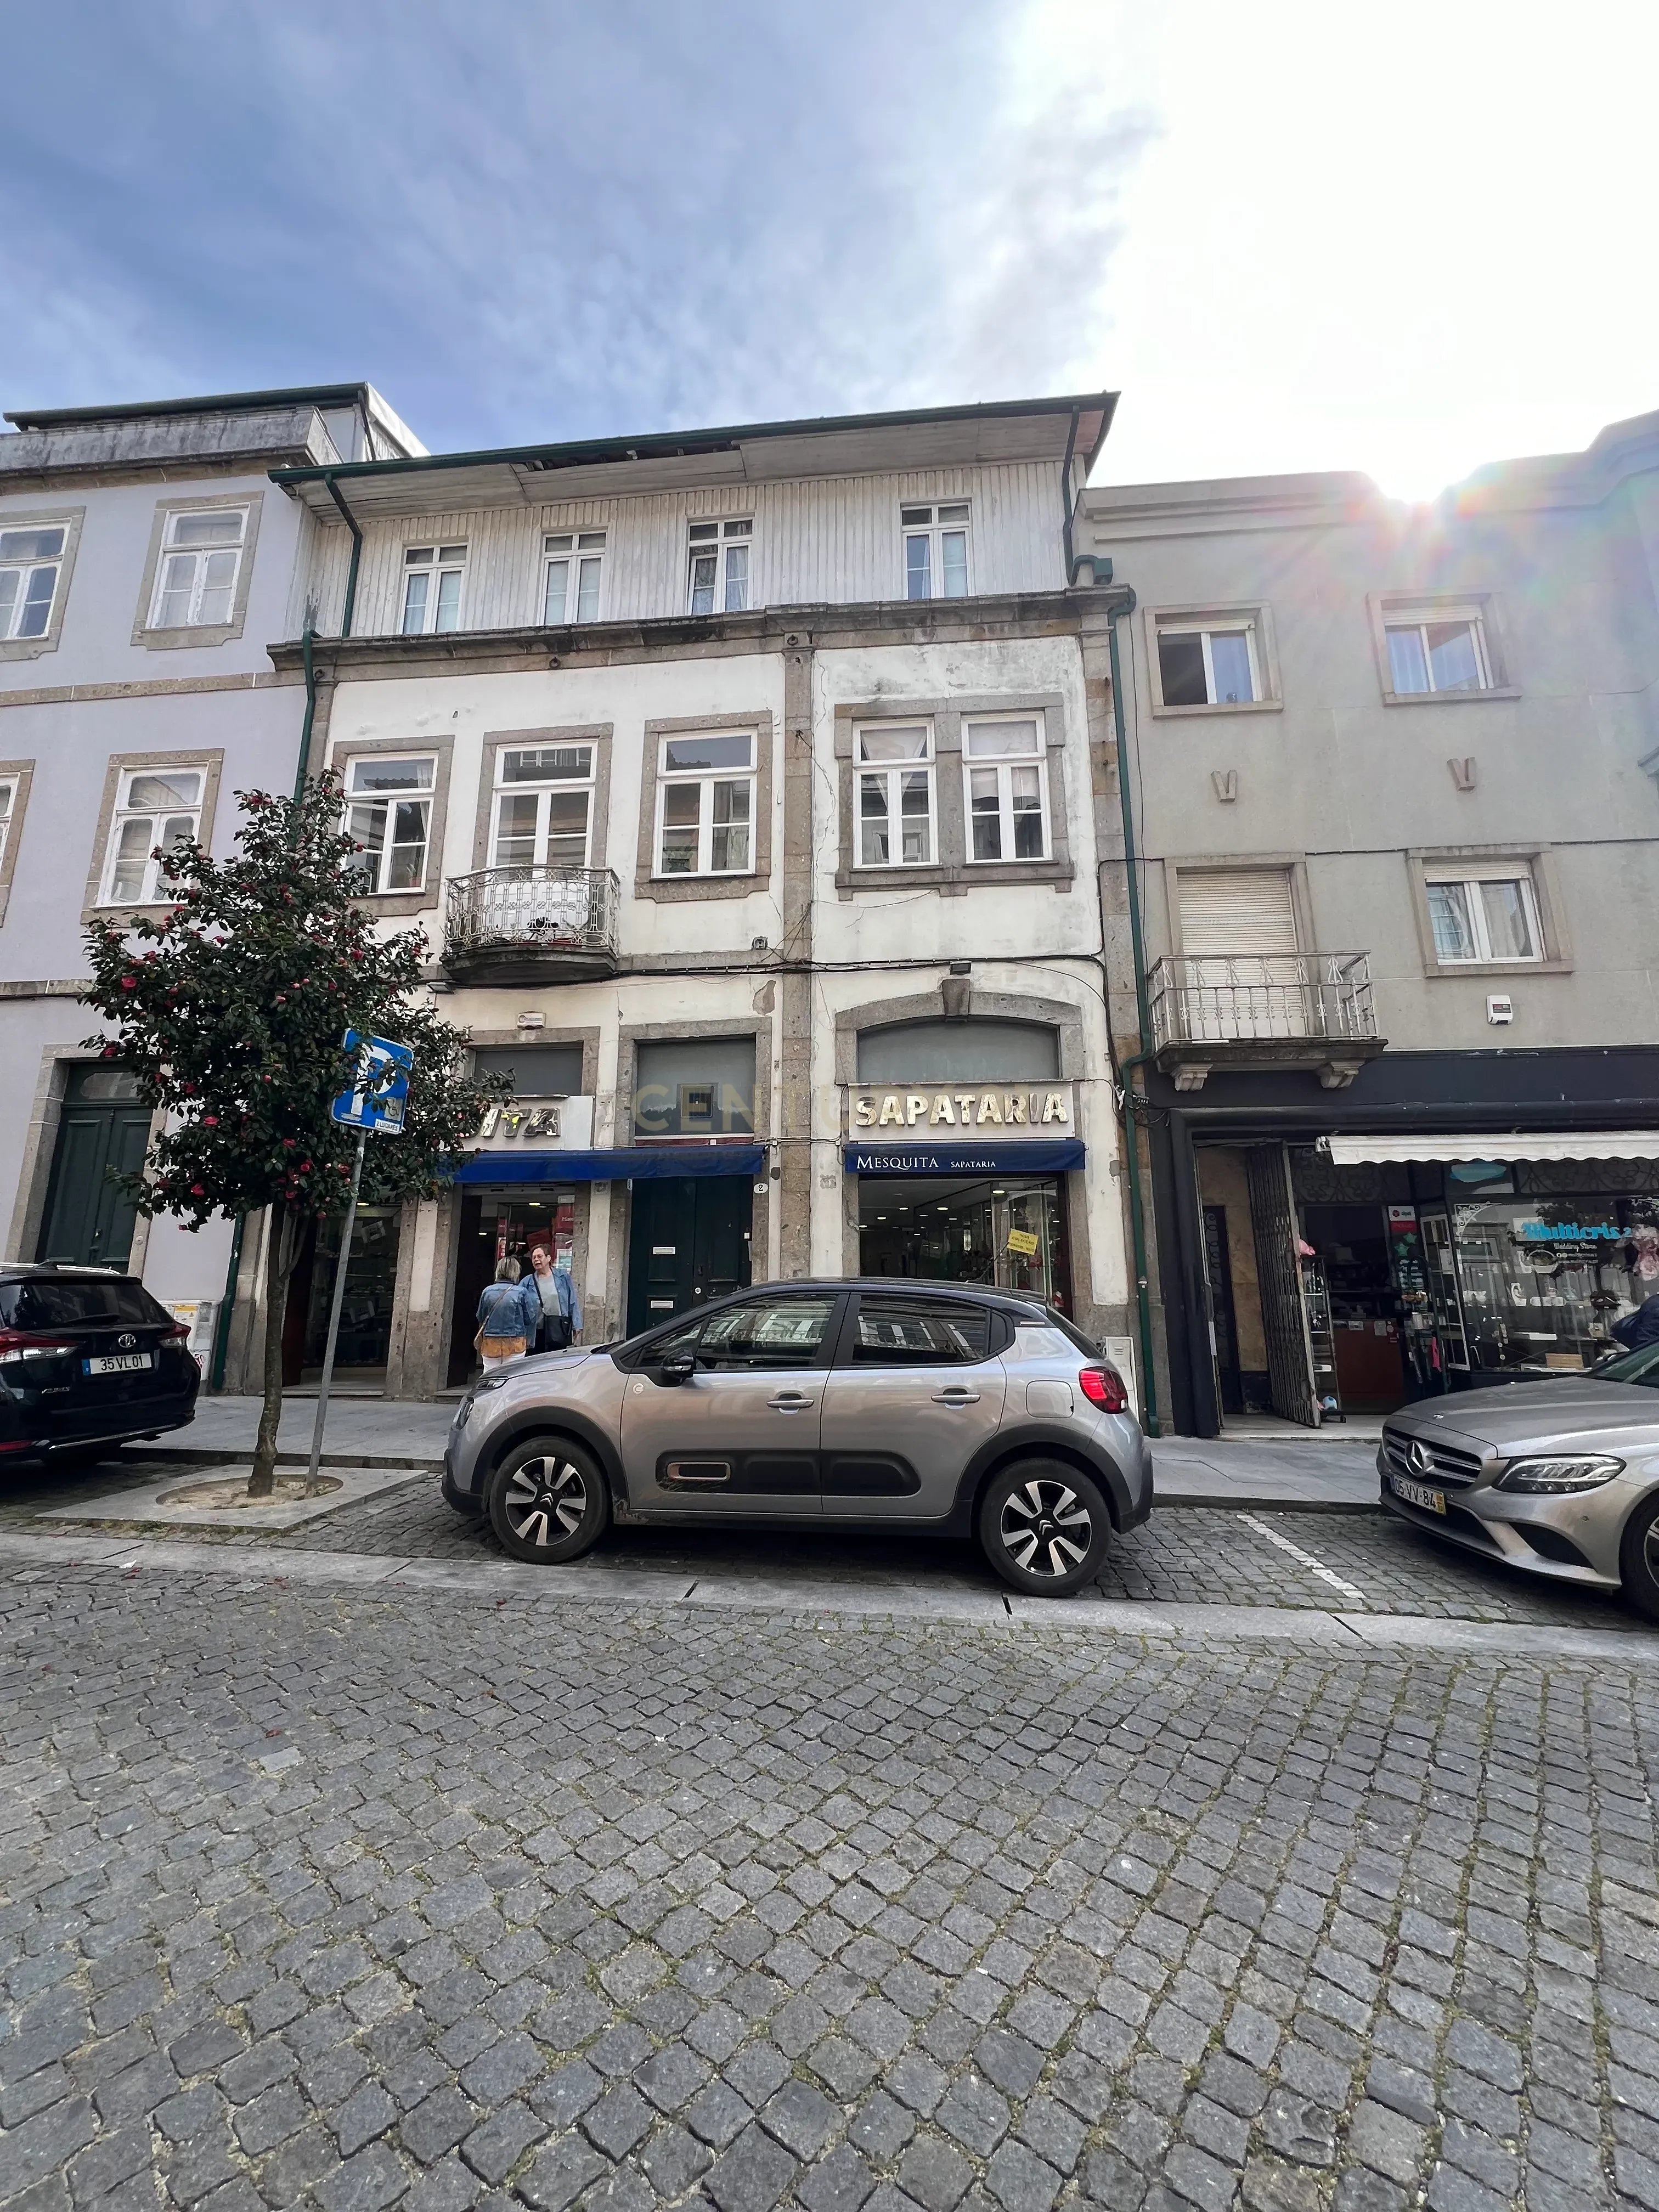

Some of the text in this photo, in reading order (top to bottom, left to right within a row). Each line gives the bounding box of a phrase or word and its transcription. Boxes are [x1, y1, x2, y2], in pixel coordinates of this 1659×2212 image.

[855, 1093, 1068, 1127] SAPATARIA
[380, 1122, 398, 1131] LUGARES
[856, 1155, 939, 1170] MESQUITA
[101, 1355, 143, 1371] 35 VL 01
